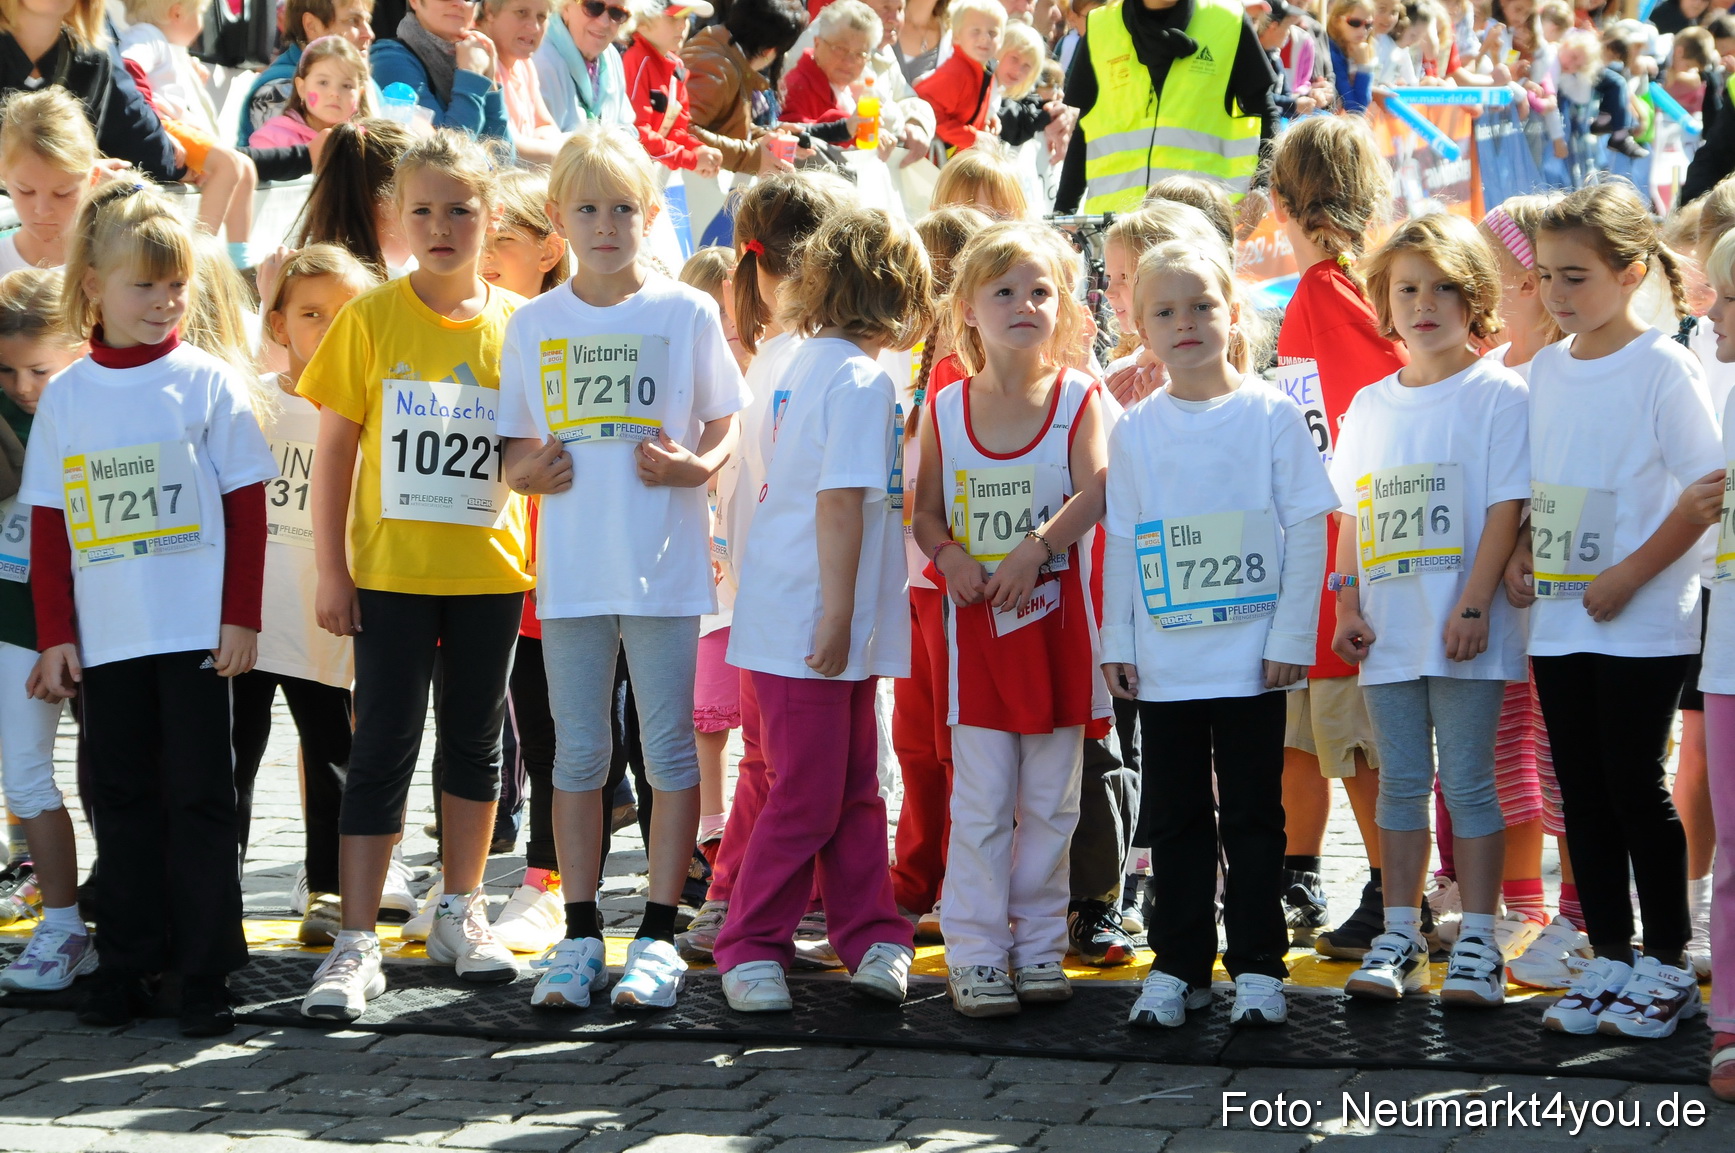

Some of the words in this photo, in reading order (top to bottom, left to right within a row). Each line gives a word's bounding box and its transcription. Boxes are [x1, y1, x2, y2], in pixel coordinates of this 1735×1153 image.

[573, 344, 638, 364] Victoria
[574, 375, 656, 406] 7210
[396, 389, 495, 421] Natascha
[616, 423, 661, 437] PFLEIDERER
[391, 428, 503, 483] 10221
[90, 456, 156, 481] Melanie
[264, 479, 309, 511] 31
[411, 494, 453, 504] PFLEIDERER
[969, 477, 1031, 499] Tamara
[1375, 474, 1446, 500] Katharina
[98, 483, 183, 524] 7217
[973, 505, 1051, 542] 7041
[1170, 524, 1202, 548] Ella
[1377, 505, 1451, 542] 7216
[148, 531, 201, 548] PFLEIDERER
[1176, 552, 1266, 590] 7228
[1411, 555, 1462, 567] PFLEIDERER
[1553, 581, 1591, 592] PFLEIDE
[1228, 601, 1276, 615] PFLEIDERER
